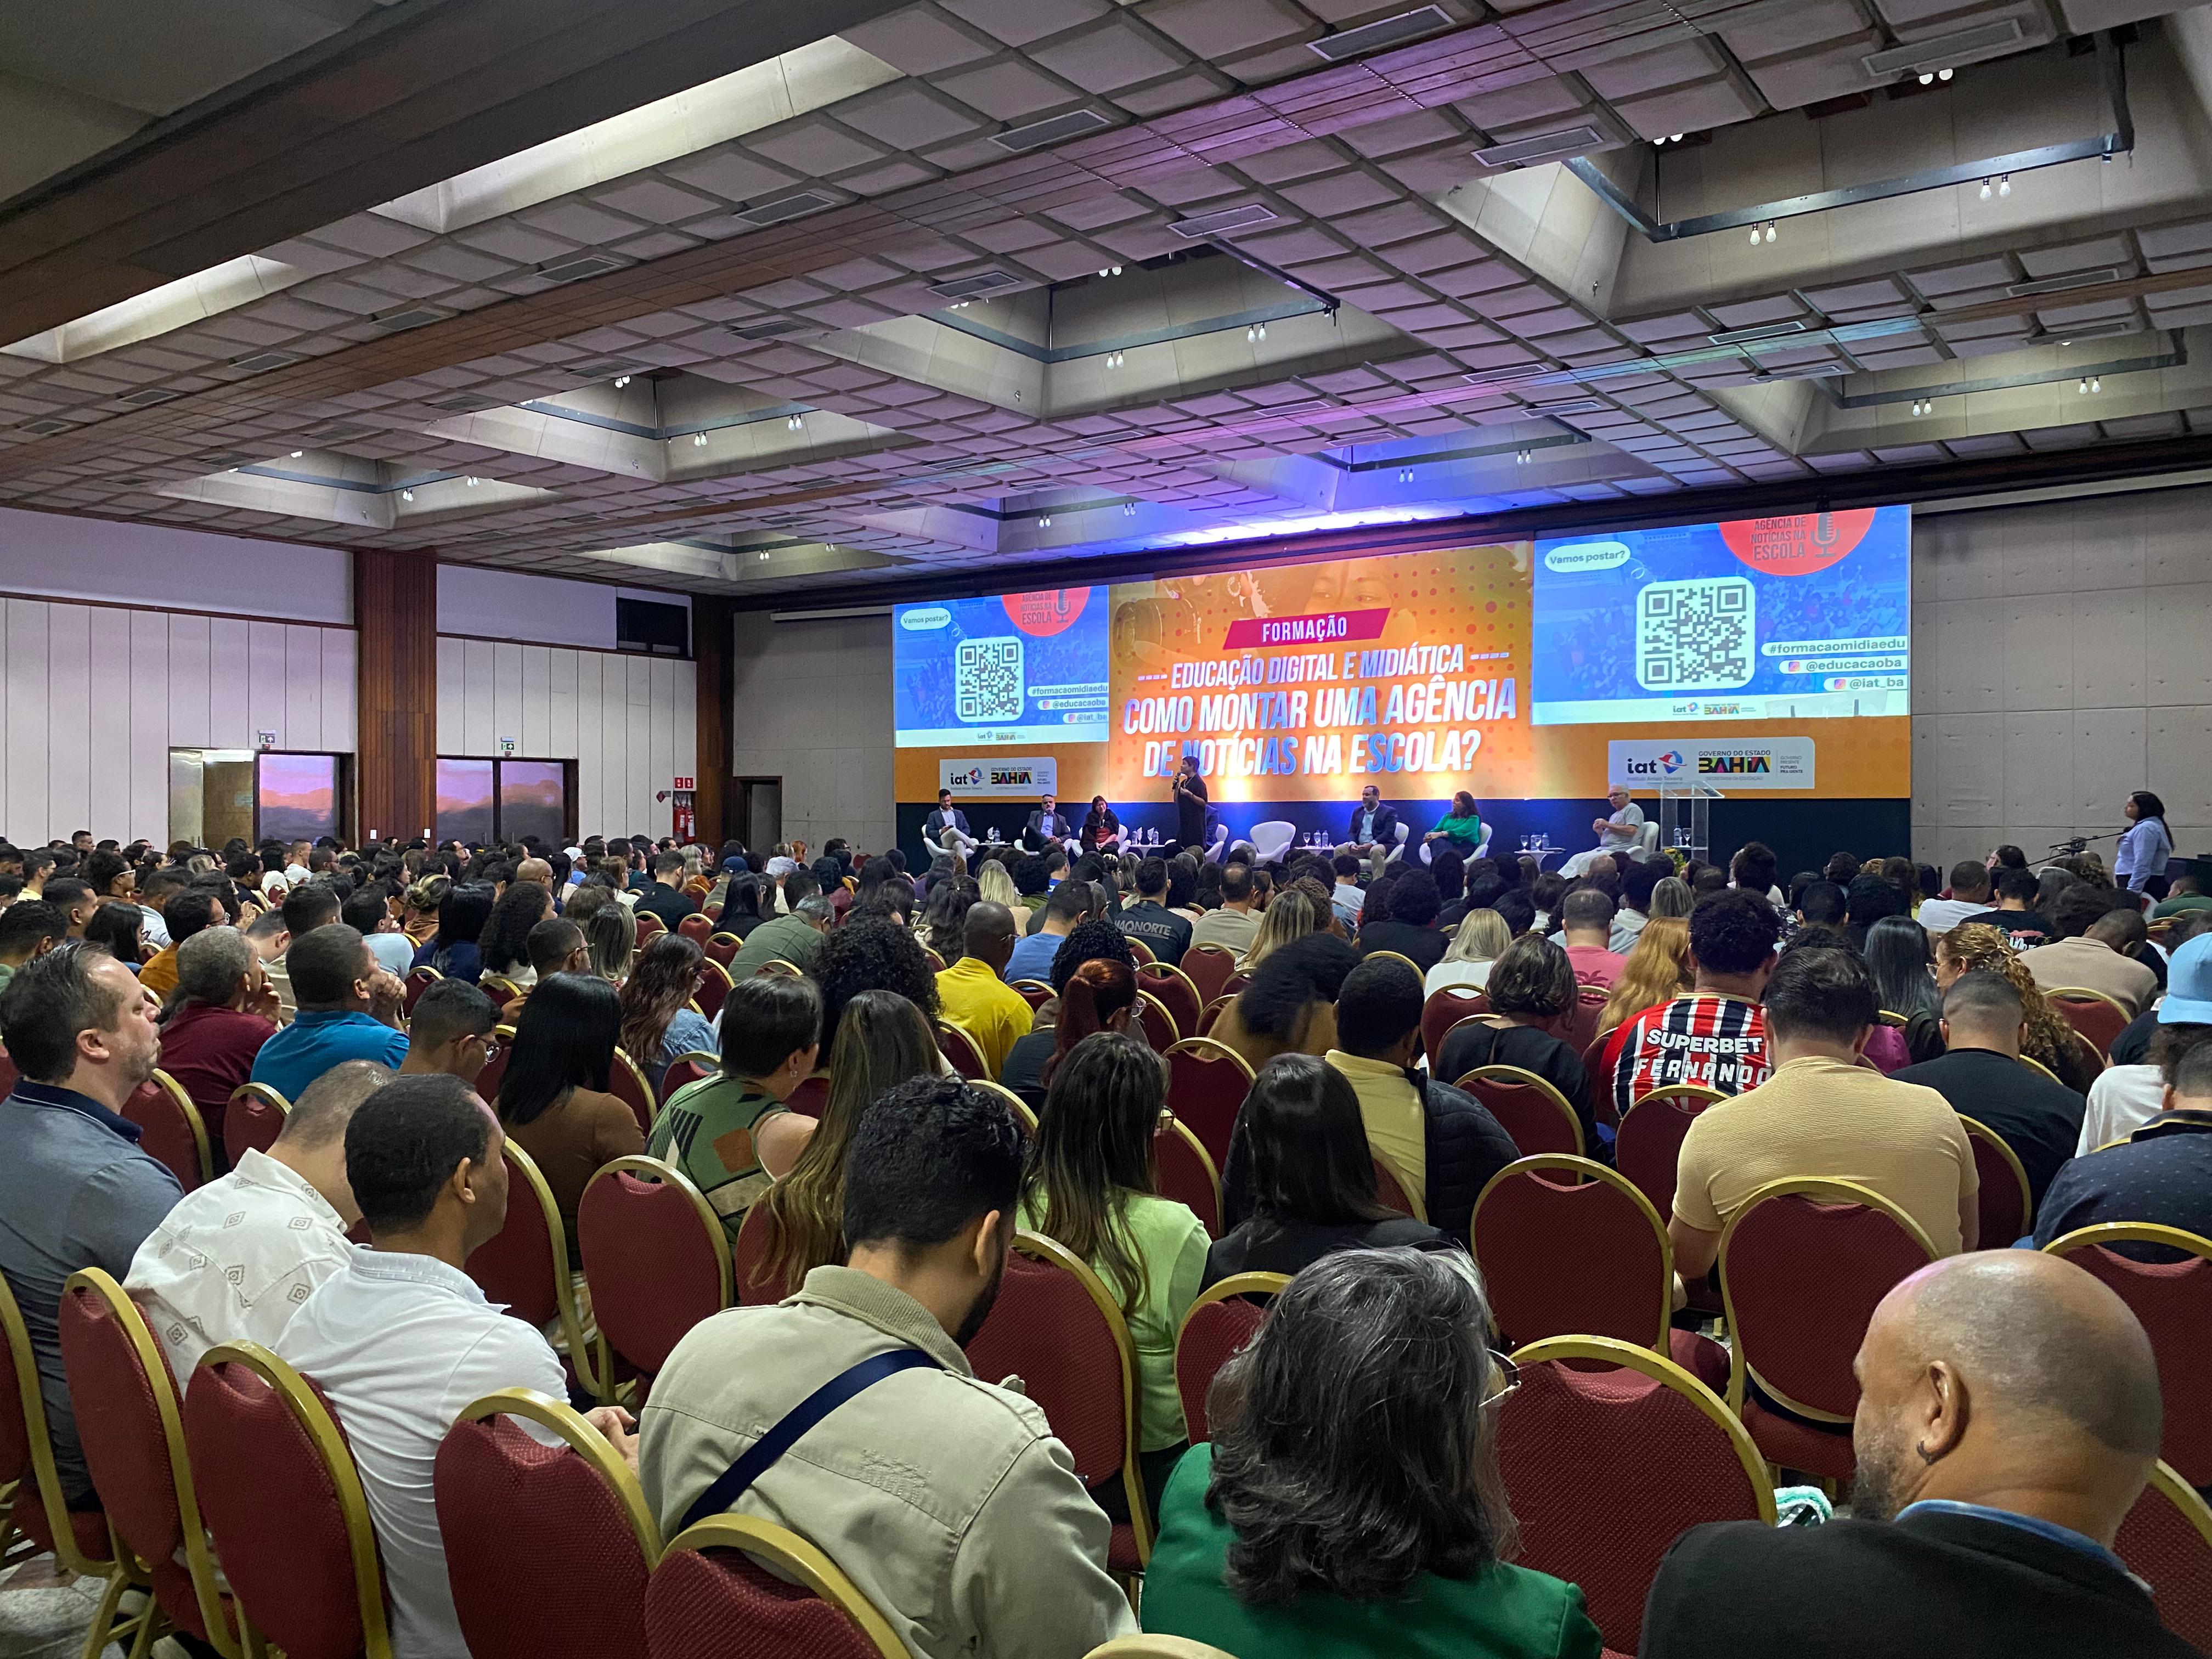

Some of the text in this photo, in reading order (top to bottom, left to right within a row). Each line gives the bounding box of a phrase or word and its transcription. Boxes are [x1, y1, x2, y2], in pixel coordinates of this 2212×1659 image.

[1754, 517, 1805, 531] AGÊNCIA DE
[1751, 529, 1805, 544] NOTÍCIAS NA
[1550, 550, 1625, 564] Vamos postar?
[1754, 541, 1805, 561] ESCOLA
[1045, 592, 1052, 600] DE
[925, 614, 949, 624] postar?
[1022, 611, 1052, 624] ESCOLA
[1262, 614, 1347, 642] FORMAÇÃO
[1770, 639, 1905, 654] #formacaomidiaedu
[1171, 641, 1464, 691] EDUCAÇÃO DIGITAL E MIDIÁTICA
[1806, 658, 1901, 672] @educacaoba
[1032, 684, 1108, 695] #formacaomidiaedu
[1850, 678, 1904, 690] @iat_ba
[1053, 698, 1106, 709] @educacaoba
[1124, 674, 1516, 735] COMO MONTAR UMA AGÊNCIA
[1077, 713, 1107, 722] @iat_ba
[1143, 741, 1176, 777] DE
[1303, 734, 1342, 775] NA
[1348, 729, 1481, 774] ESCOLA?
[1627, 758, 1657, 774] iat
[950, 772, 968, 785] iat
[1646, 1029, 1763, 1054] SUPERBET
[1636, 1058, 1772, 1086] FERNANDO
